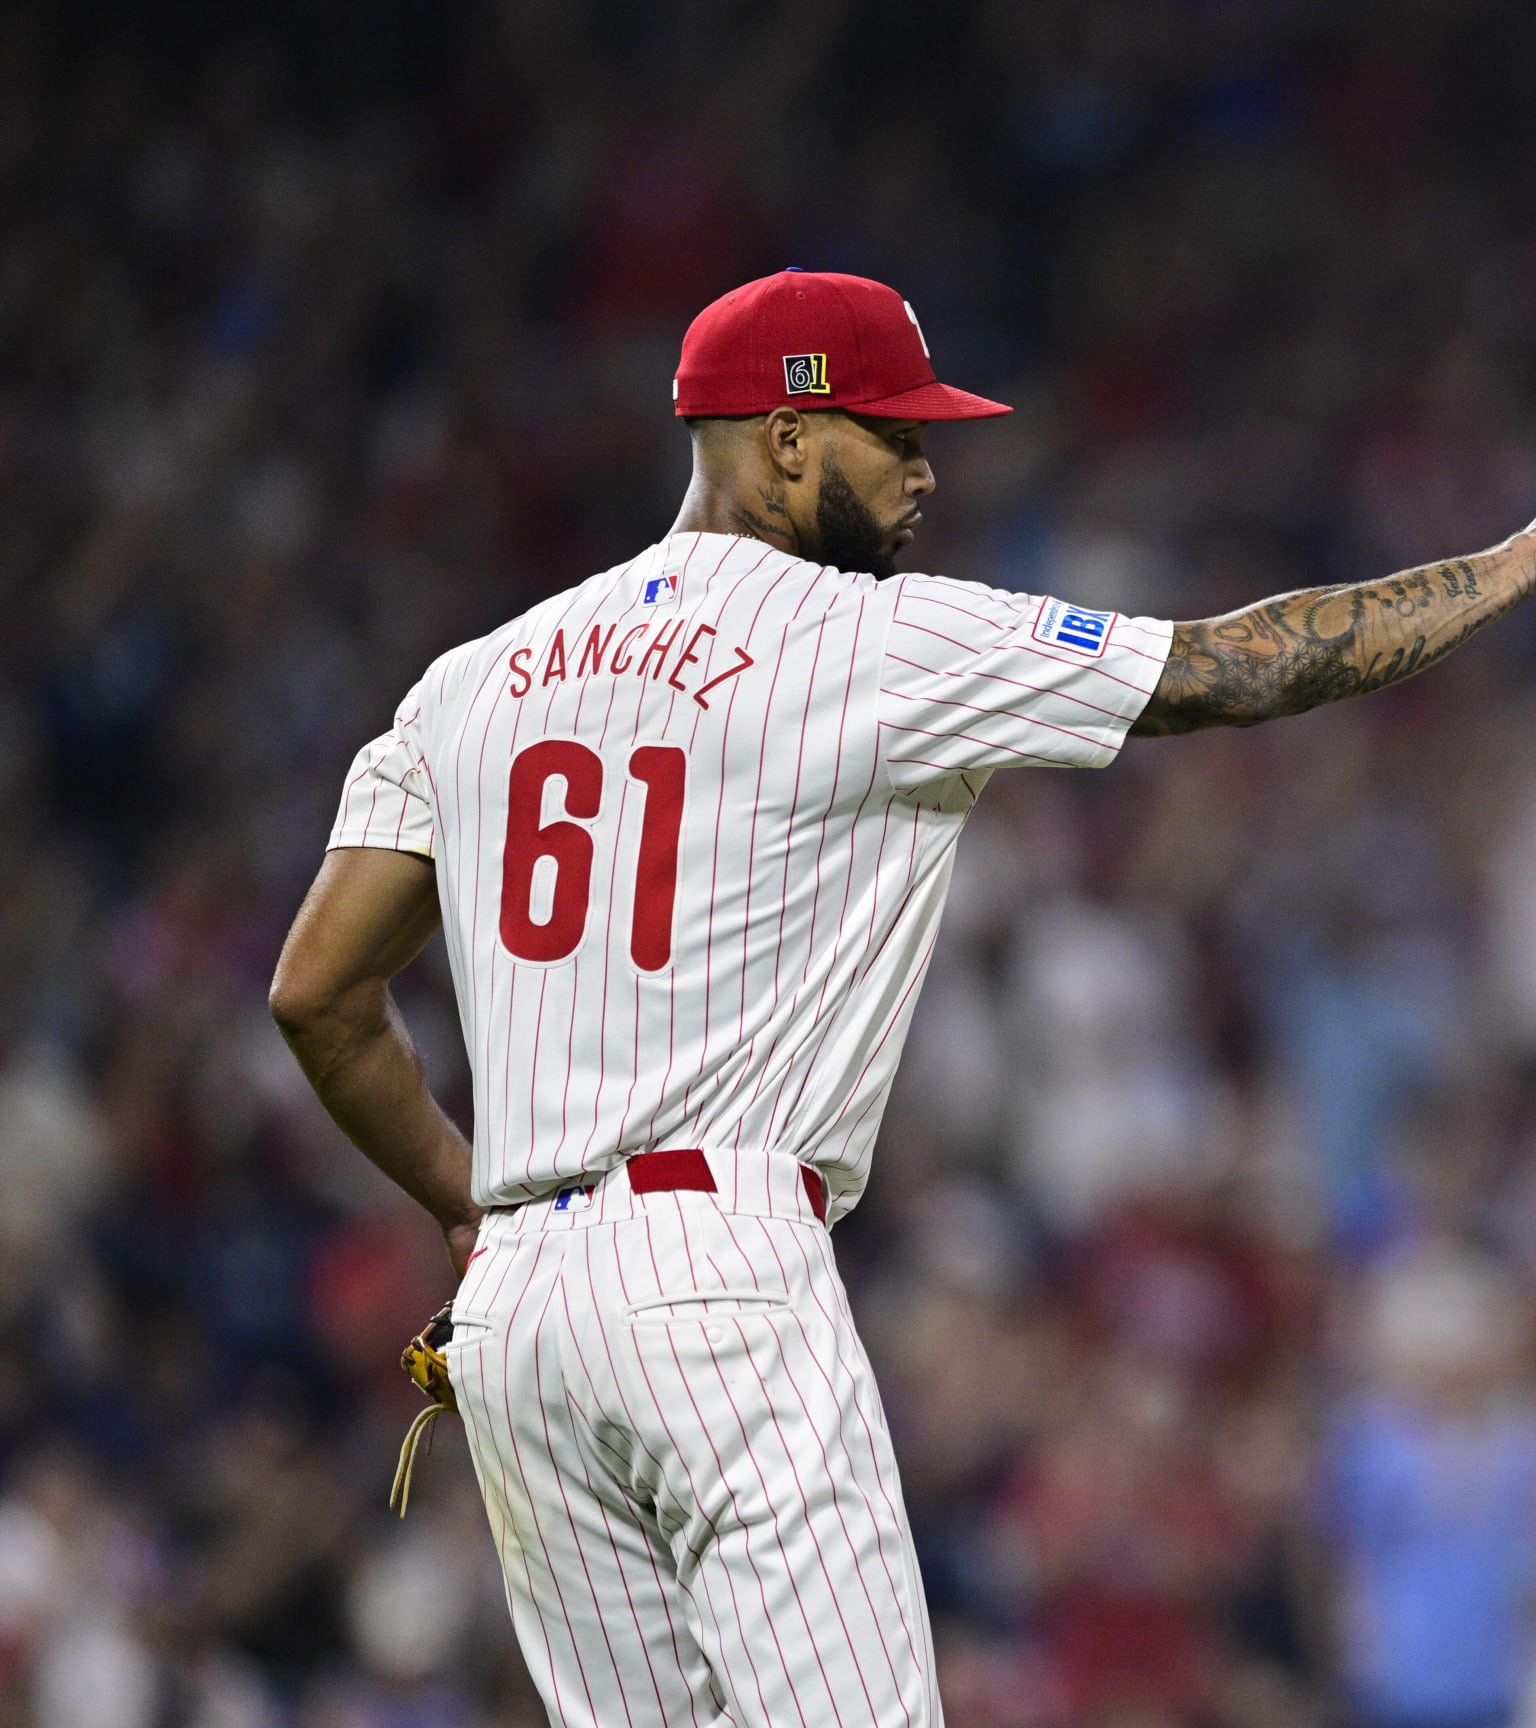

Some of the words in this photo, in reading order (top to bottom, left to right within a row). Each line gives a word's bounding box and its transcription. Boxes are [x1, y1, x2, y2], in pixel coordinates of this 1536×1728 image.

[787, 354, 830, 393] 61
[1056, 605, 1110, 651] IBX
[509, 619, 754, 711] SANCHEZ
[499, 740, 686, 971] 61
